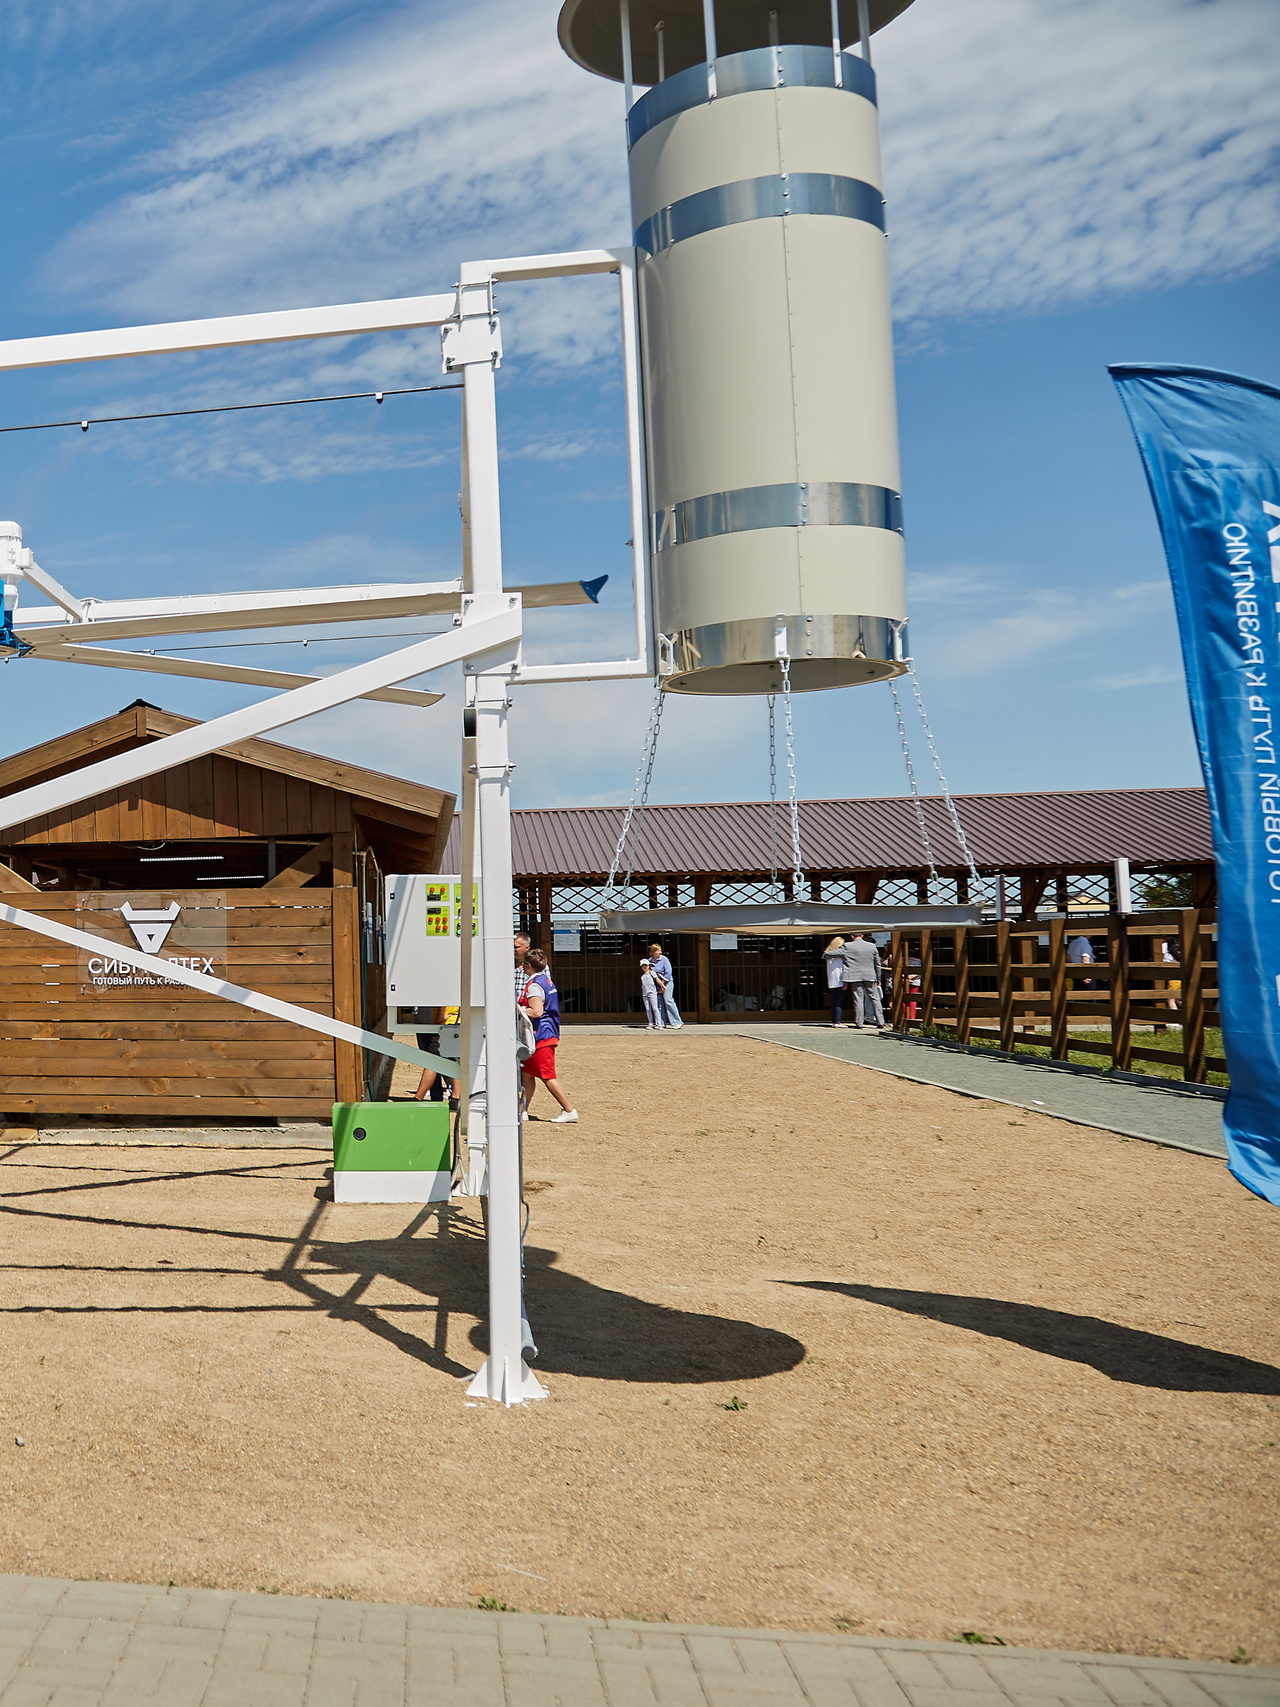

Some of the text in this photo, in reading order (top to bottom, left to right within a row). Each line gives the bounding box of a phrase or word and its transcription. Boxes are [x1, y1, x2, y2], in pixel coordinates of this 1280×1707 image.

[87, 957, 215, 974] СИБТЕХ
[92, 975, 132, 985] ГОТОВЫЙ
[134, 977, 156, 985] ПУТЬ
[157, 977, 163, 985] К
